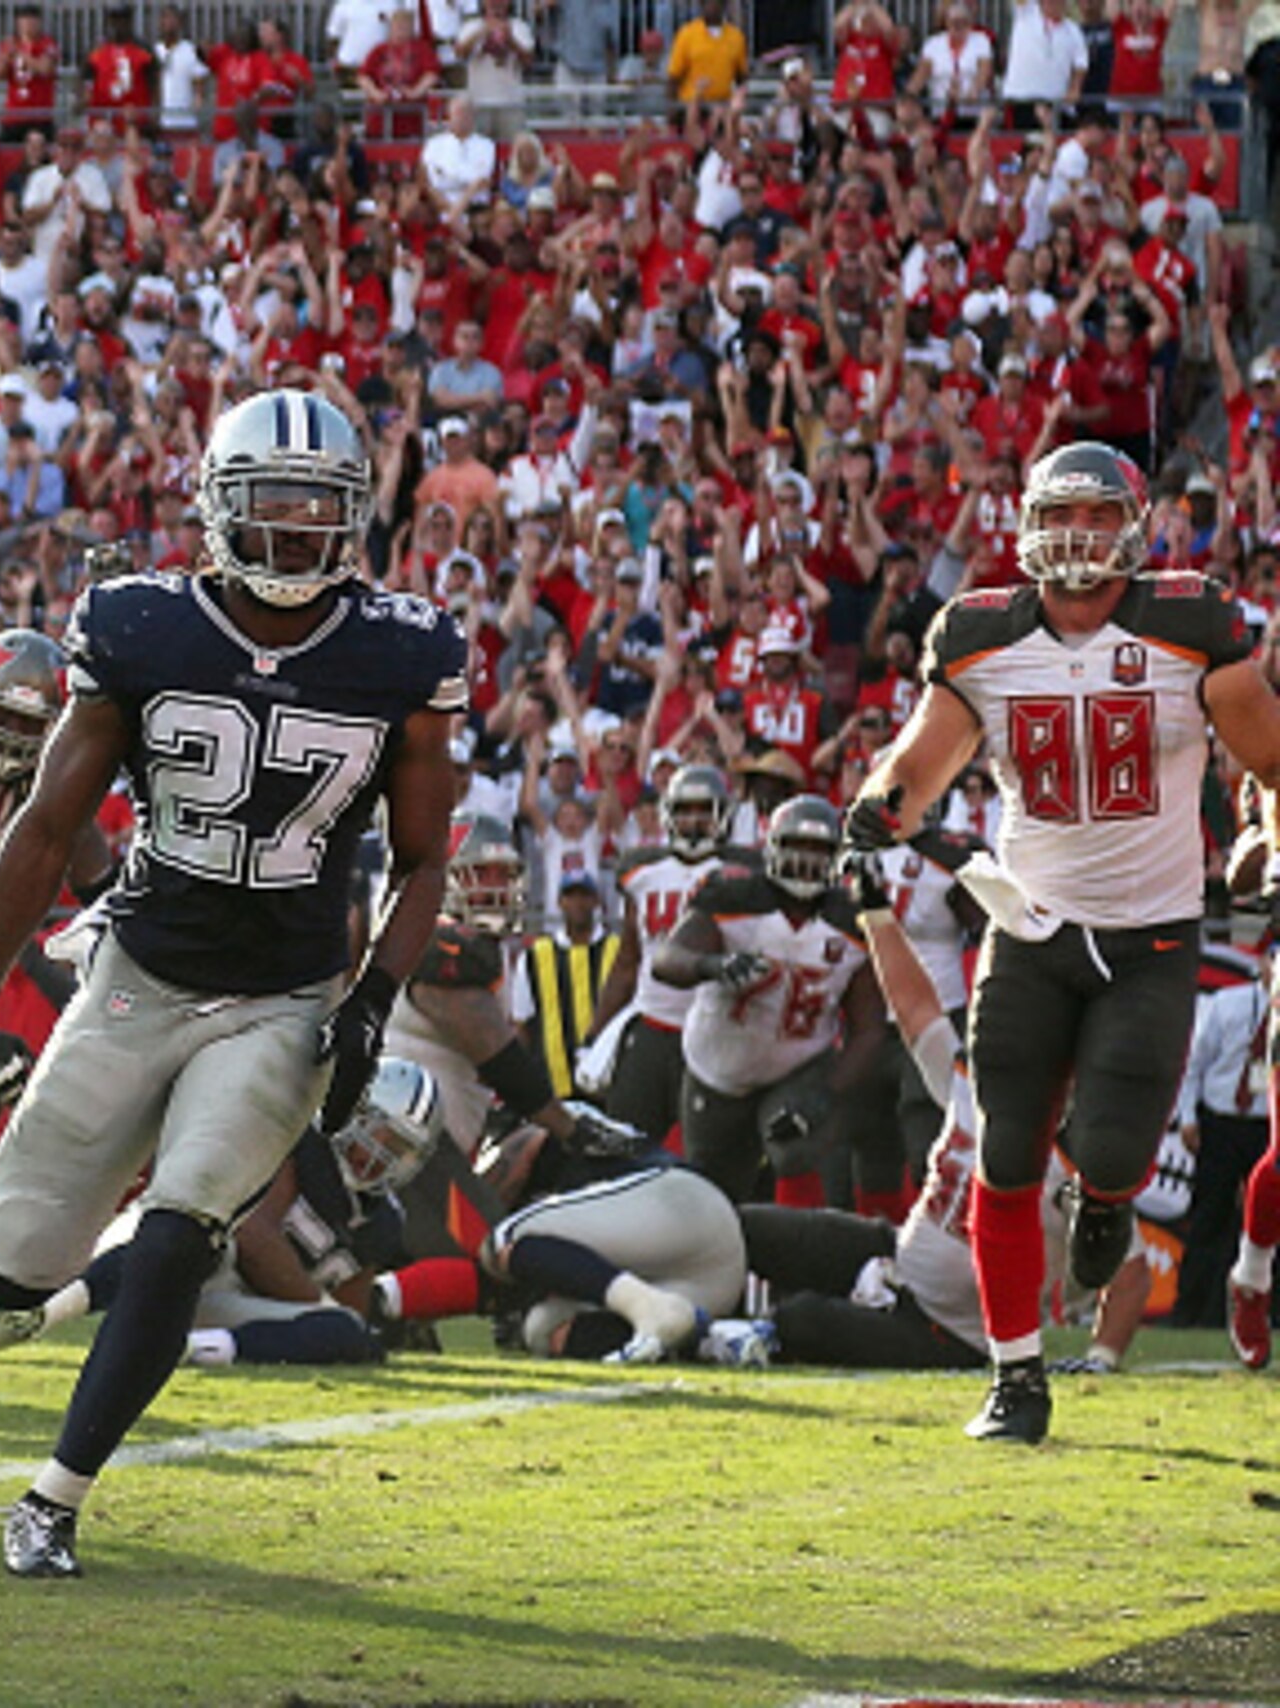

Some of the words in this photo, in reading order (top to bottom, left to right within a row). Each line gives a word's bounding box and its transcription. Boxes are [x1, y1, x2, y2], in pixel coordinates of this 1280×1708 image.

[142, 690, 390, 890] 27
[1006, 691, 1159, 824] 88
[728, 956, 832, 1039] 76
